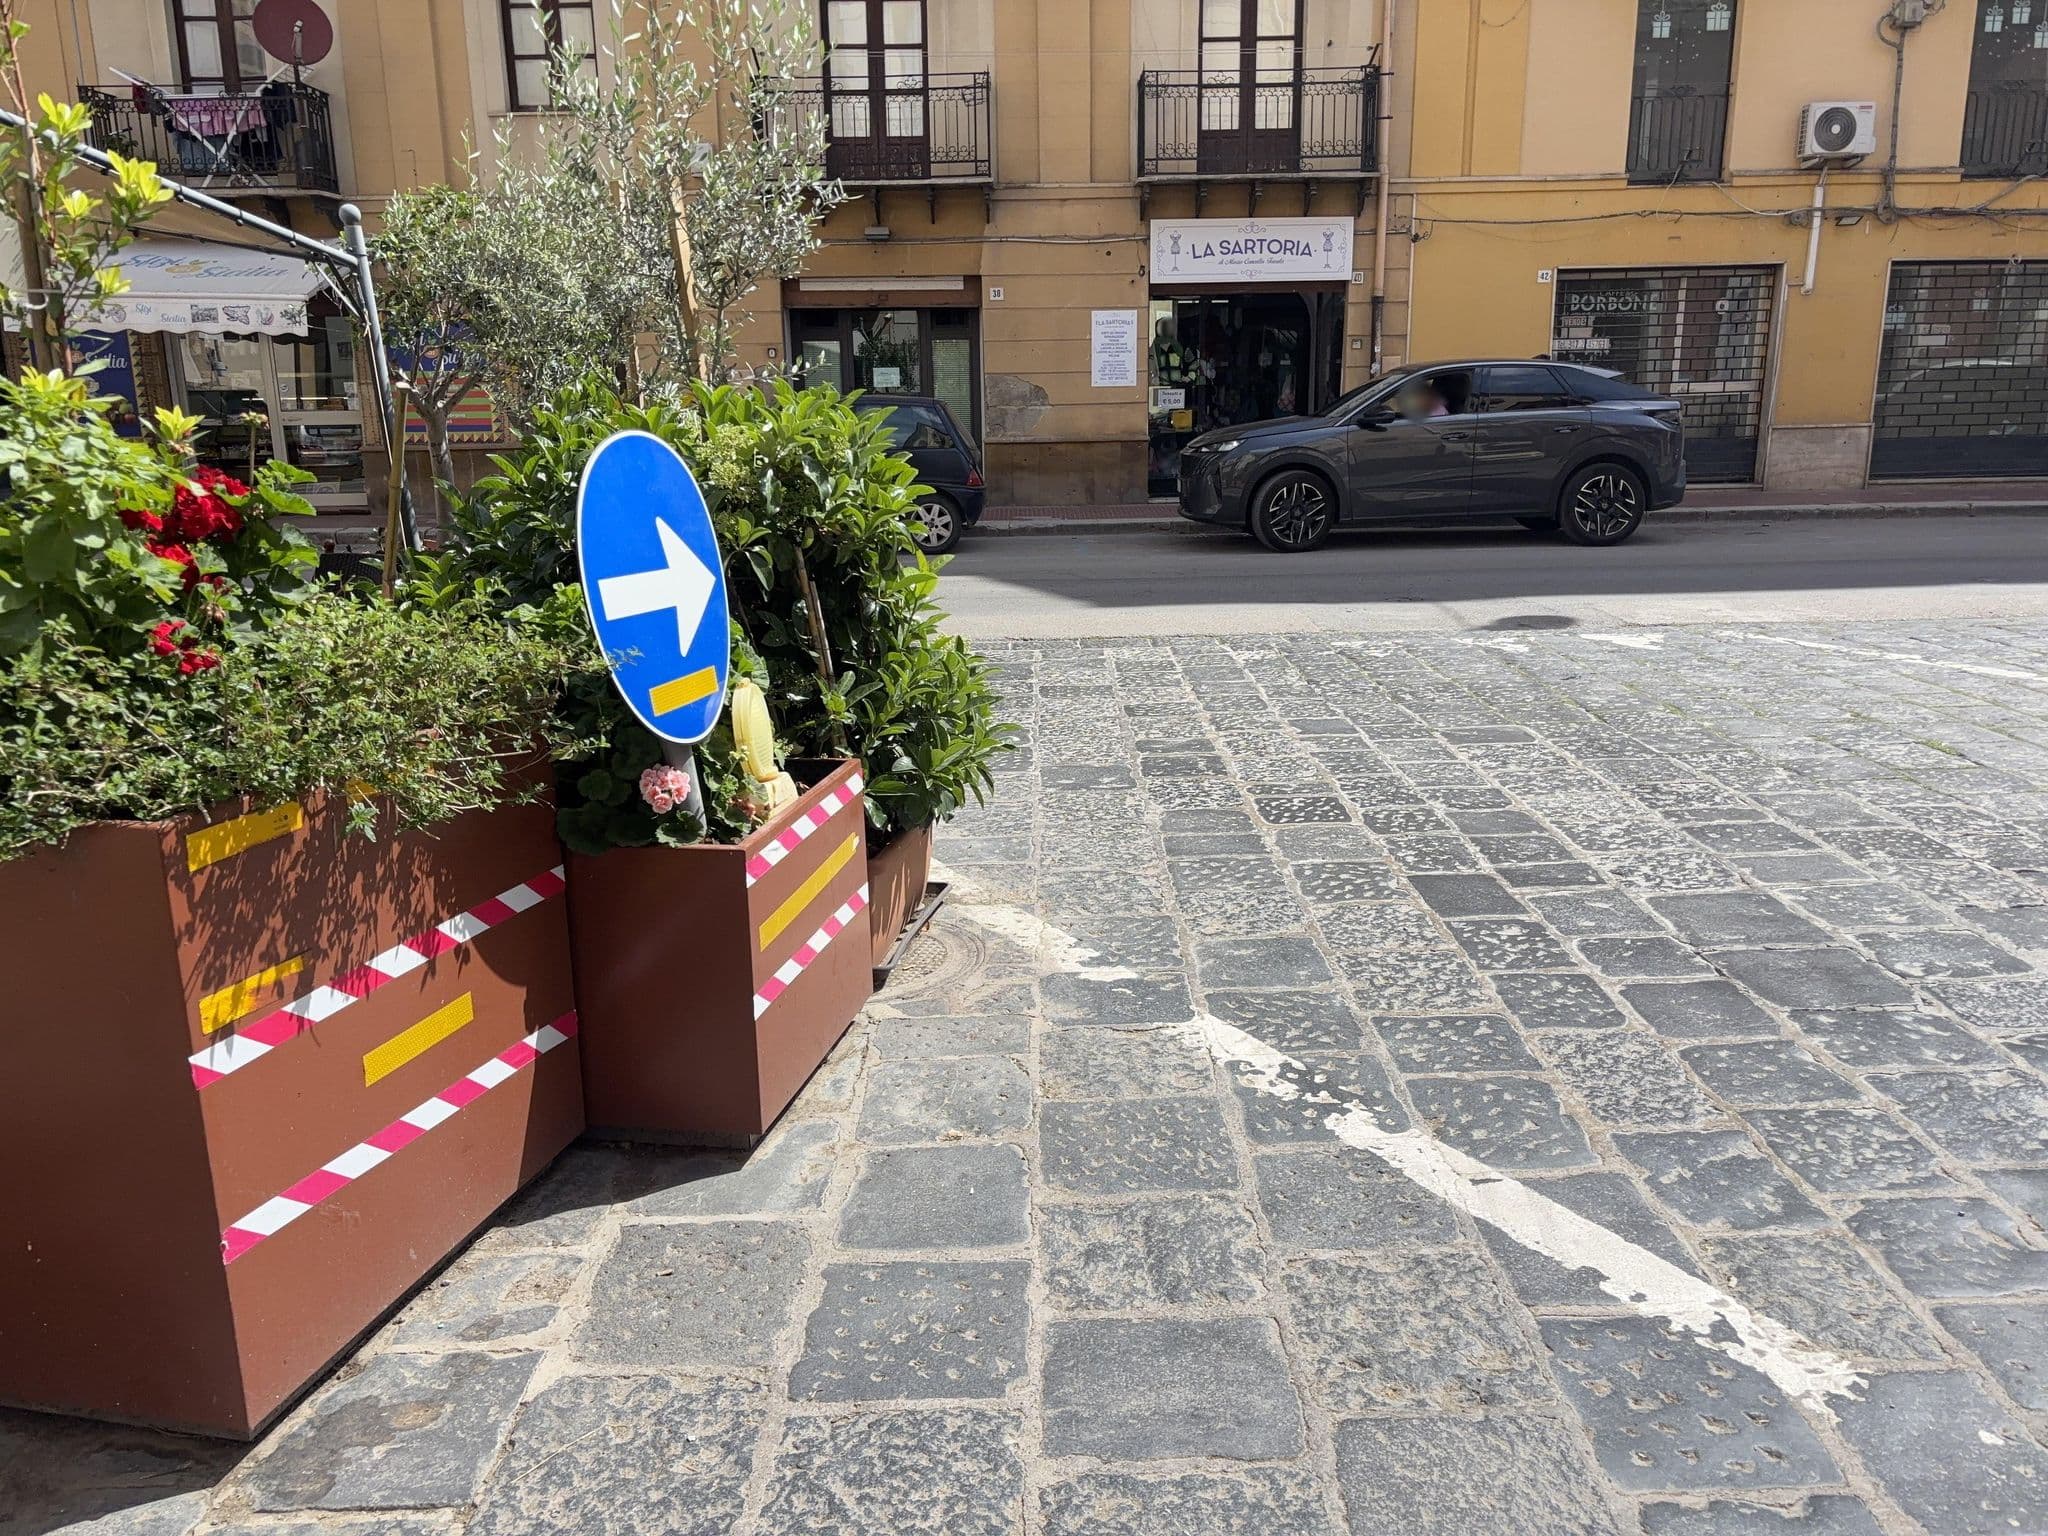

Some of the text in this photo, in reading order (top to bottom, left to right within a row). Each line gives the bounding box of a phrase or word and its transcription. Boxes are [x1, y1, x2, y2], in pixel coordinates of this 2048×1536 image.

[1191, 238, 1312, 259] LA SARTORIA
[195, 263, 289, 279] Sicilia
[1540, 272, 1550, 281] 42
[1354, 273, 1362, 283] 40
[992, 289, 1001, 298] 38
[1570, 293, 1658, 312] BORBONE
[160, 312, 186, 323] Sicilia
